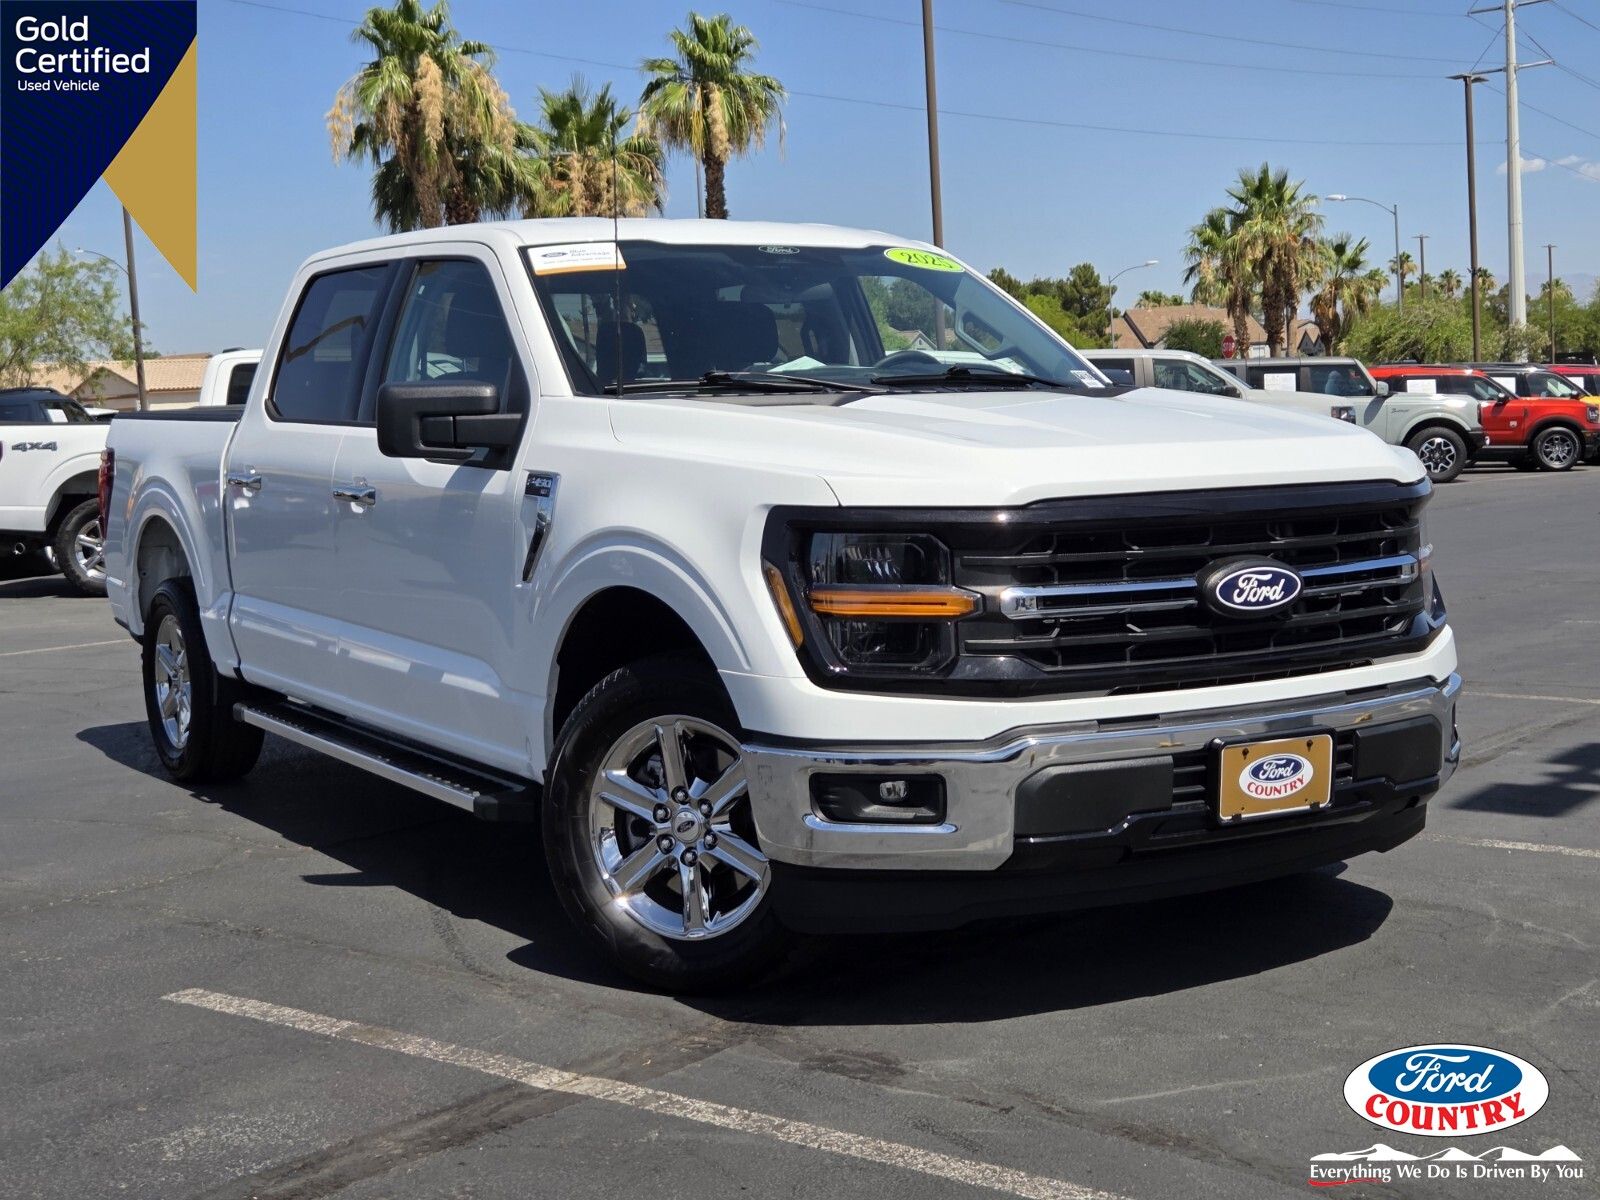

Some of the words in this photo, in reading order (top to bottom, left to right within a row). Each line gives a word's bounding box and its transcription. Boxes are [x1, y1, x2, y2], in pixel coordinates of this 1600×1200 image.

[900, 251, 953, 269] 2025
[1232, 573, 1286, 604] Ford
[1259, 759, 1295, 781] Ford
[1247, 774, 1306, 798] COUNTRY
